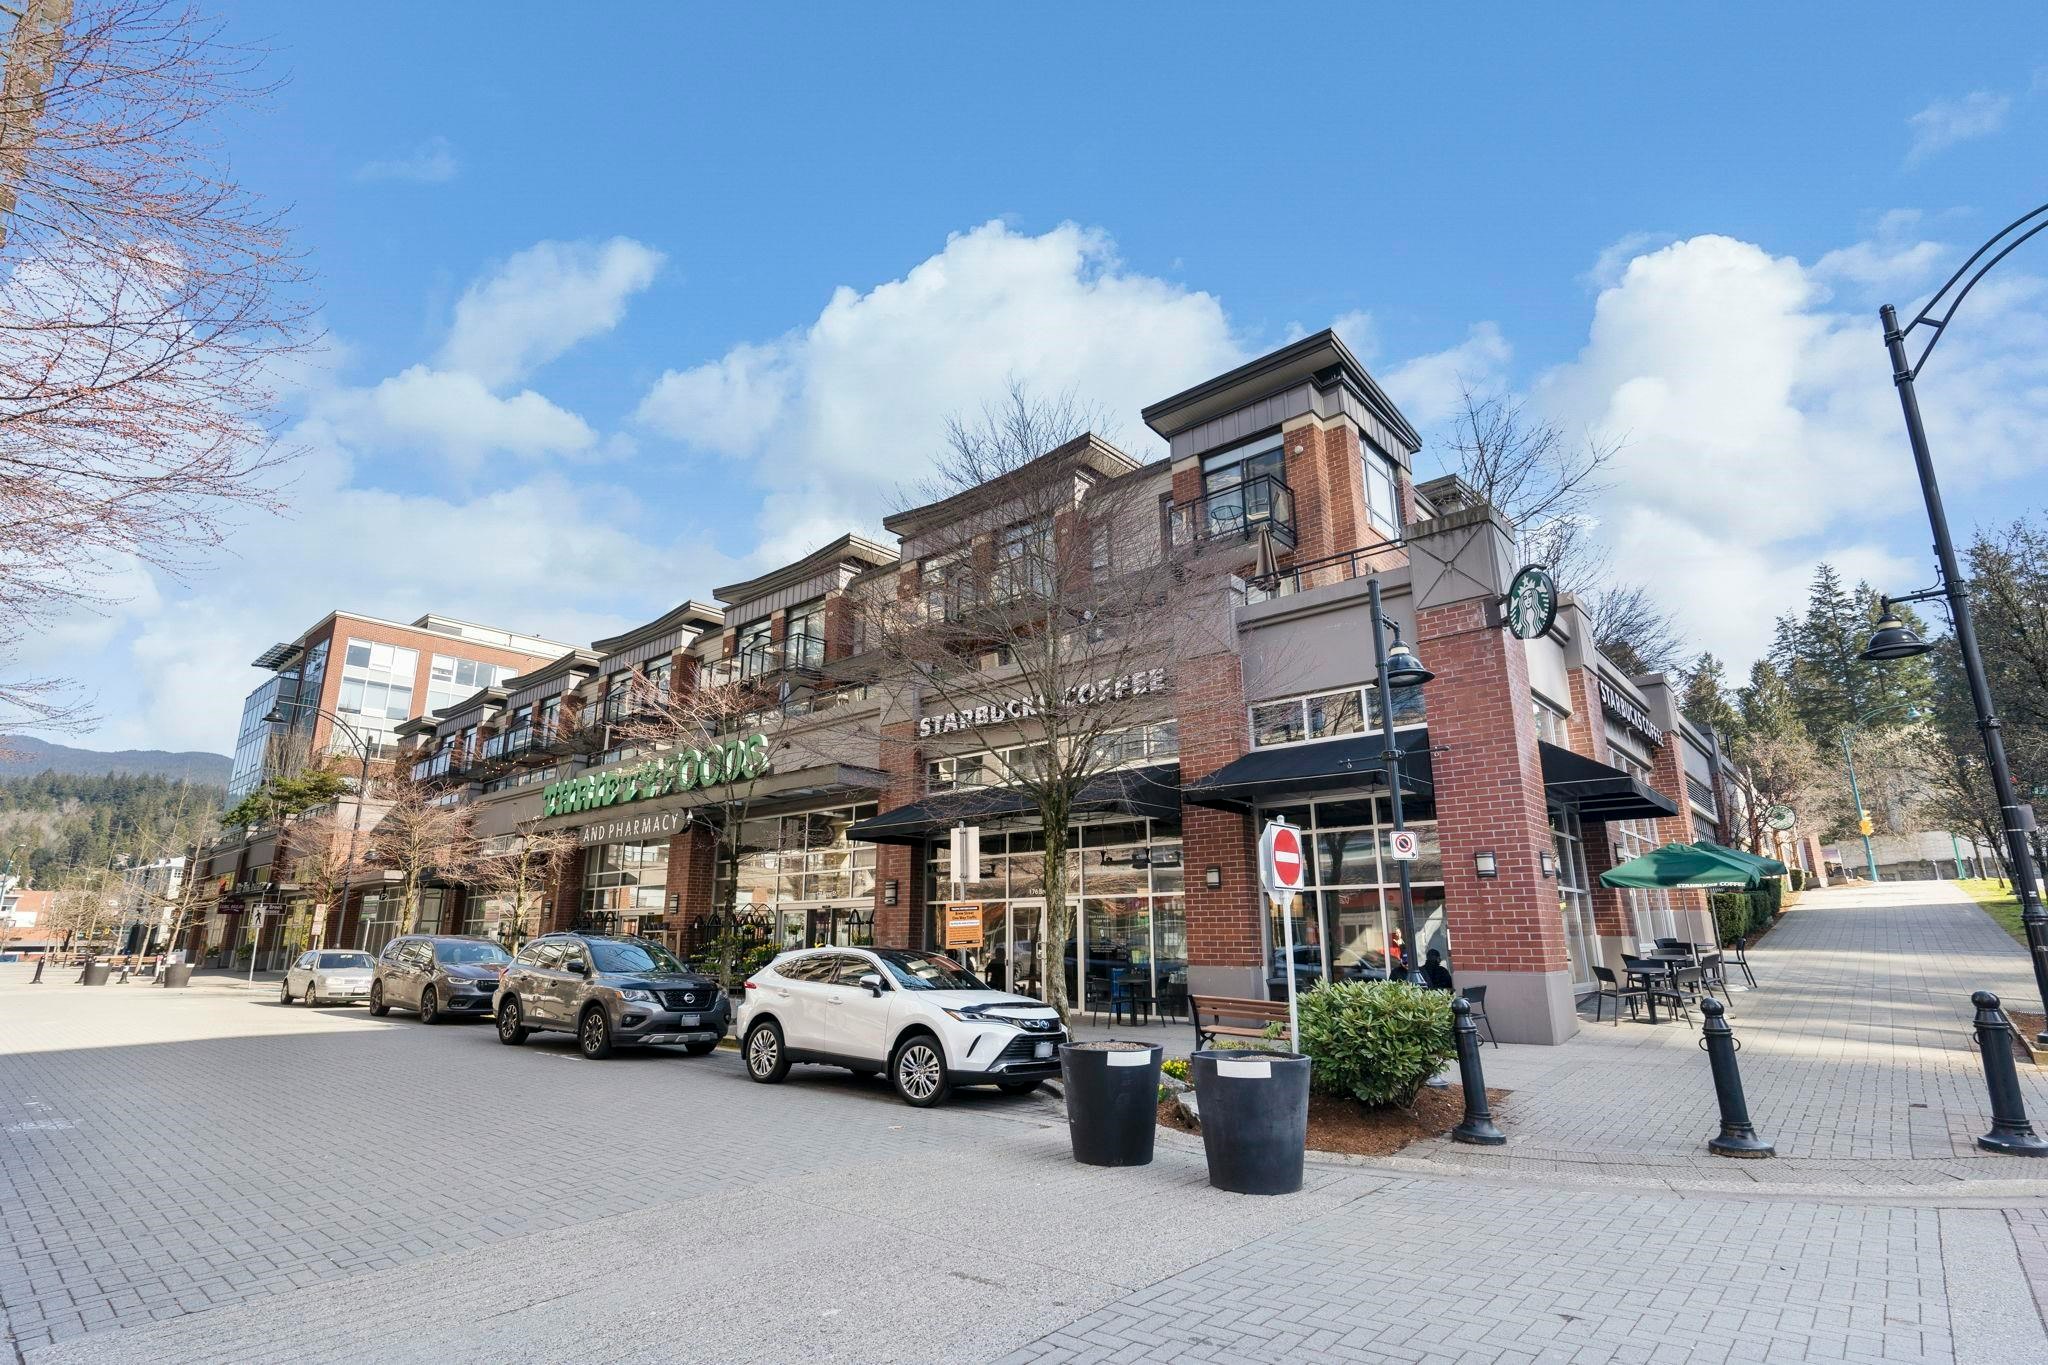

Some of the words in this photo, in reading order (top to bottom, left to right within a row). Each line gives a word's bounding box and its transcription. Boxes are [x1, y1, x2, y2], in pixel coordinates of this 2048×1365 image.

[1600, 680, 1643, 731] STARBUCKS
[583, 824, 605, 842] AND
[608, 813, 679, 839] PHARMACY
